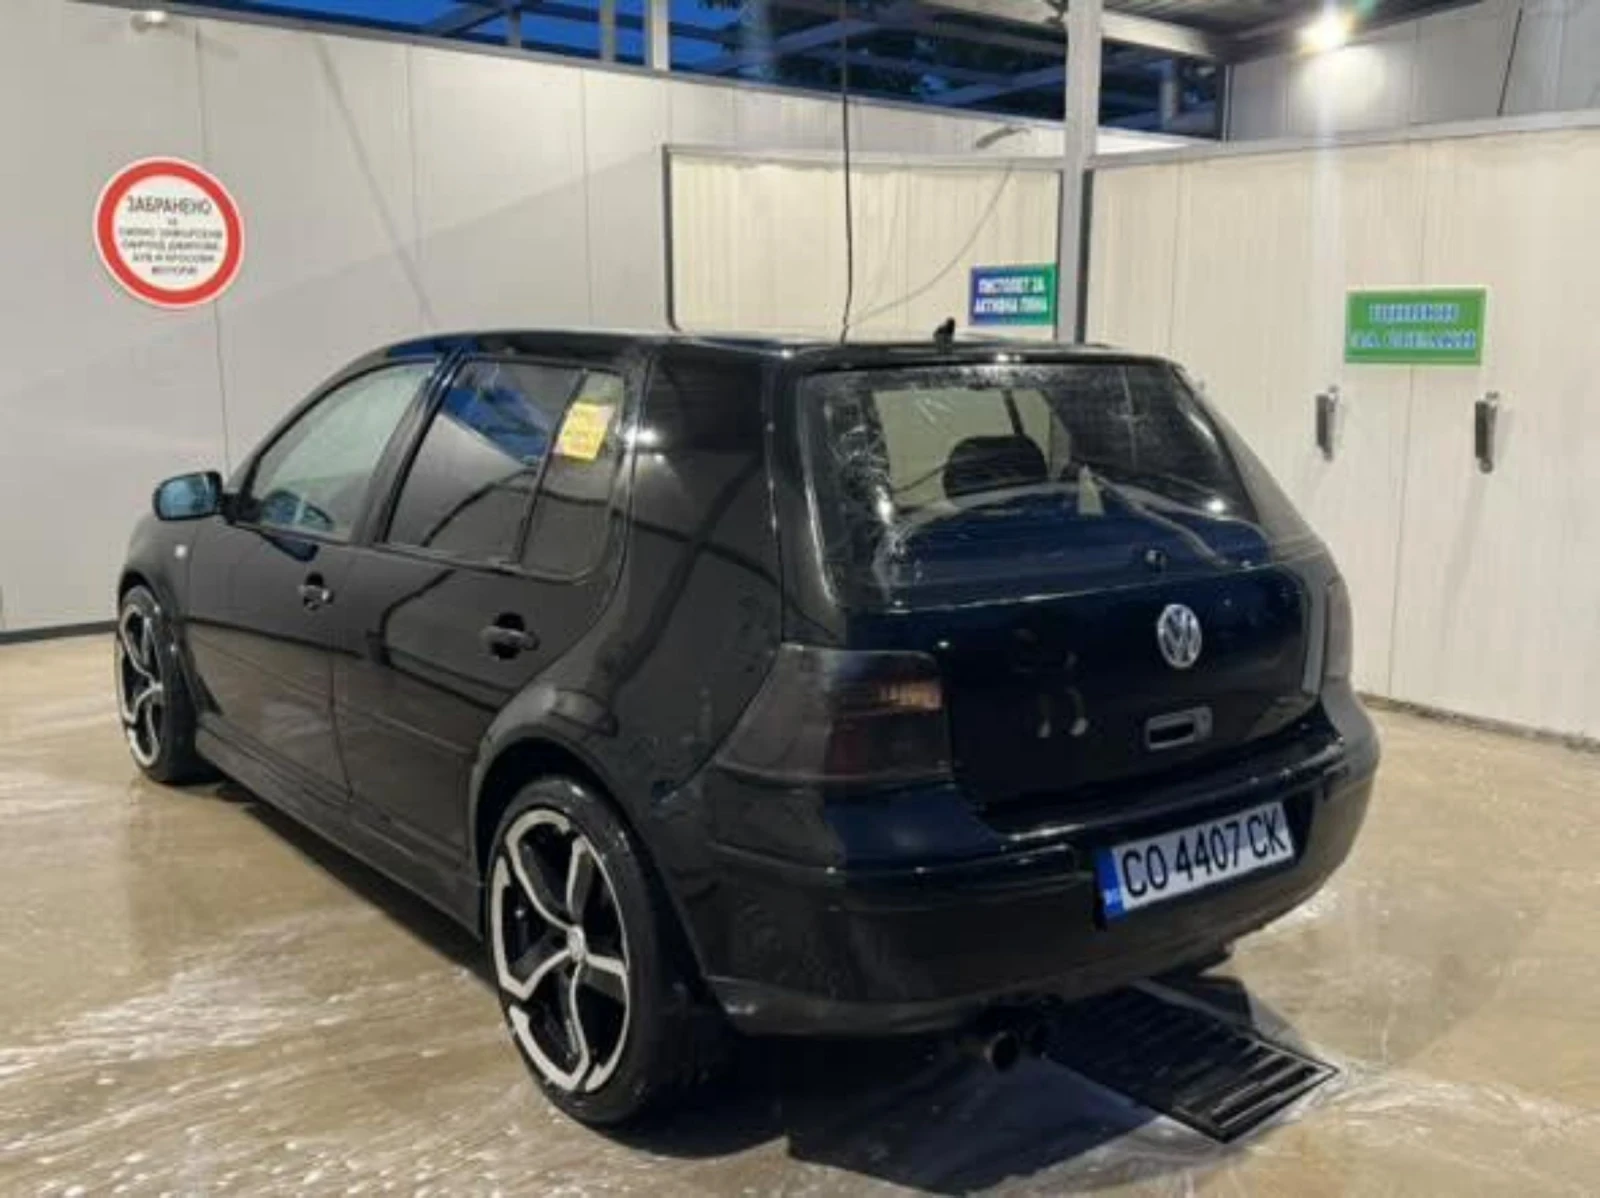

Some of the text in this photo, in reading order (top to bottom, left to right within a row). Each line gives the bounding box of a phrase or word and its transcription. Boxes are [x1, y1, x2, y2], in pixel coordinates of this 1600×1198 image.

[127, 195, 213, 215] ЗАБРАНЕНО
[1122, 807, 1287, 897] CO 4407 CK
